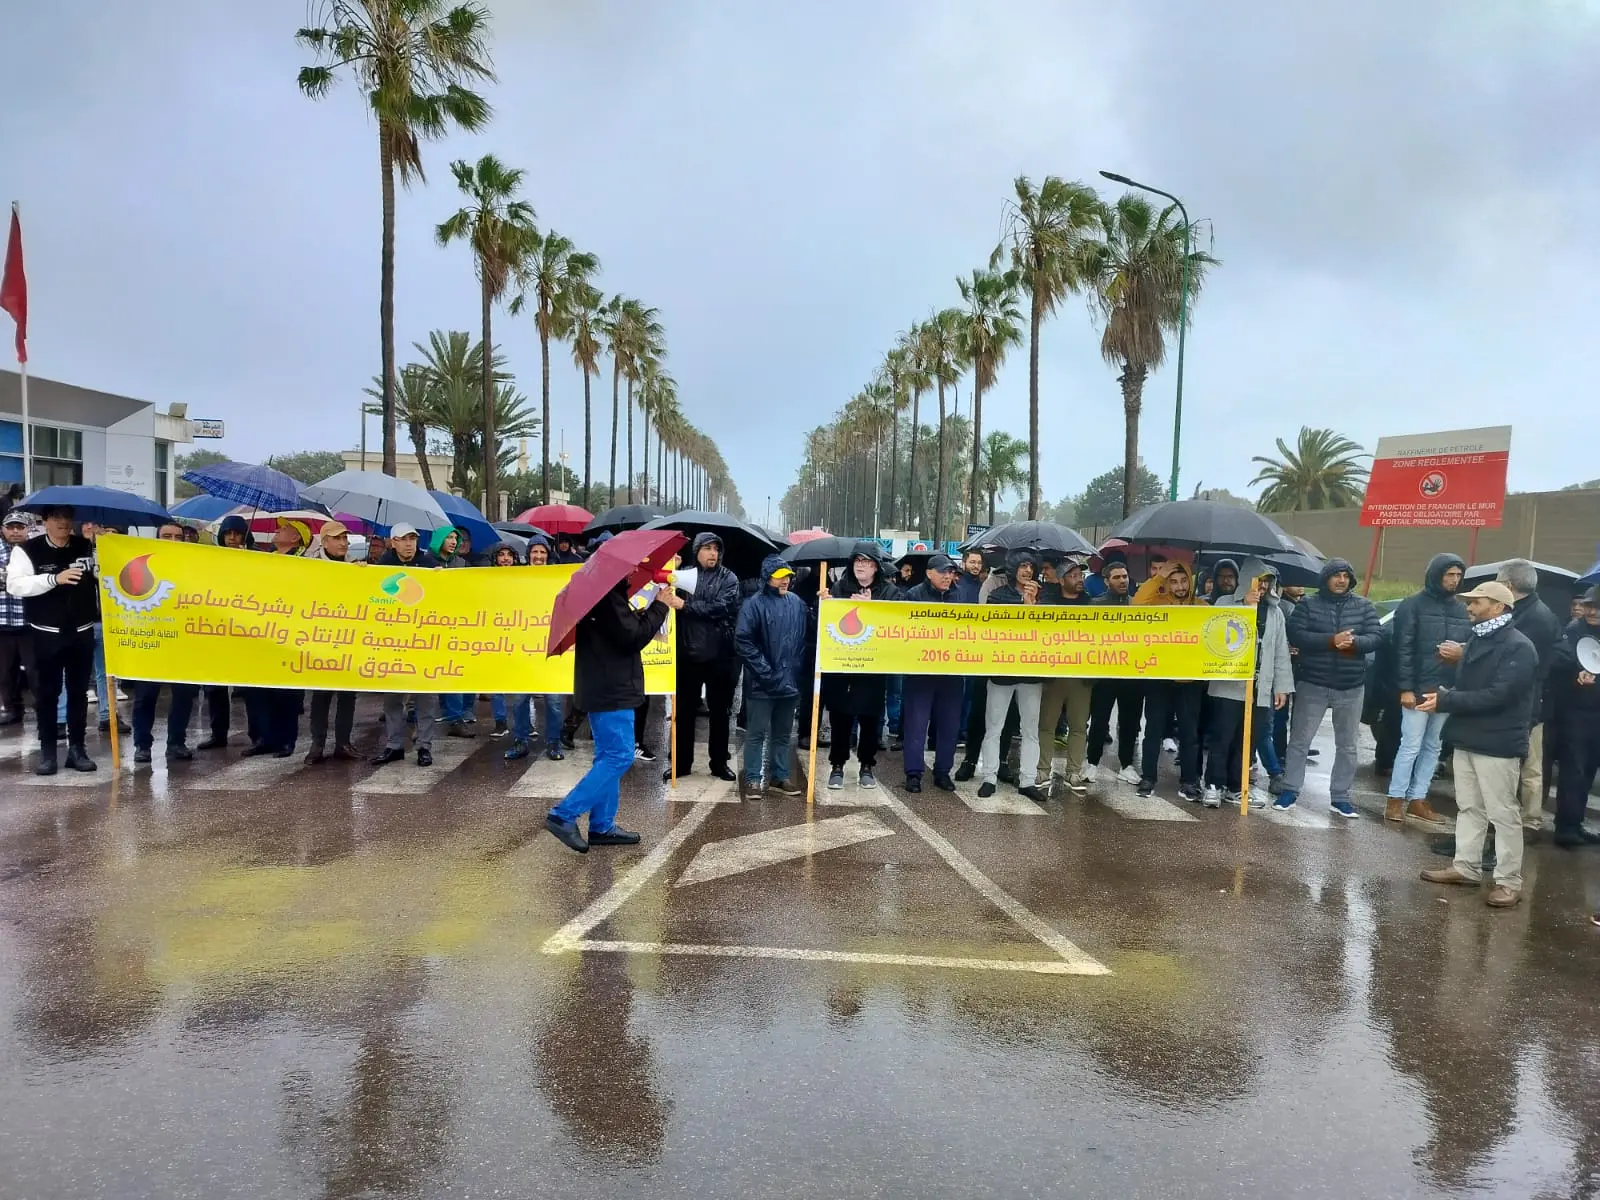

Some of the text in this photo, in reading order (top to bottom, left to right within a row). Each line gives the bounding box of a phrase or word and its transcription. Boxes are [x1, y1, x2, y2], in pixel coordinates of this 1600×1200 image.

[1397, 447, 1436, 456] RAFFINERIE
[1438, 446, 1449, 454] DE
[1392, 459, 1418, 468] ZONE
[1414, 510, 1462, 518] OBLIGATOIRE
[1463, 510, 1480, 518] PAR
[1467, 502, 1477, 510] LE
[1478, 502, 1496, 510] MUR
[1413, 518, 1450, 526] PRINCIPAL
[300, 600, 369, 621] للشغل
[374, 607, 487, 630] الديمقراطية
[981, 609, 1026, 622] للشغل
[1028, 610, 1099, 623] الديمقراطية
[1102, 612, 1169, 624] الكونفدرالية
[493, 608, 551, 632] فدرالية
[184, 615, 289, 645] والمحافظة
[294, 625, 356, 649] للإنتاج
[875, 624, 1199, 647] متقاعدو سامير يطالبون السنديك بأداء الاشتراكات
[361, 632, 440, 653] الطبيعية
[447, 636, 515, 656] بالعودة
[954, 649, 984, 663] سنة
[991, 650, 1016, 663] منذ
[1019, 650, 1082, 668] المتوقفة
[1086, 650, 1129, 666] CIMR
[1134, 652, 1158, 674] في
[358, 656, 417, 678] حقوق
[423, 659, 465, 679] على
